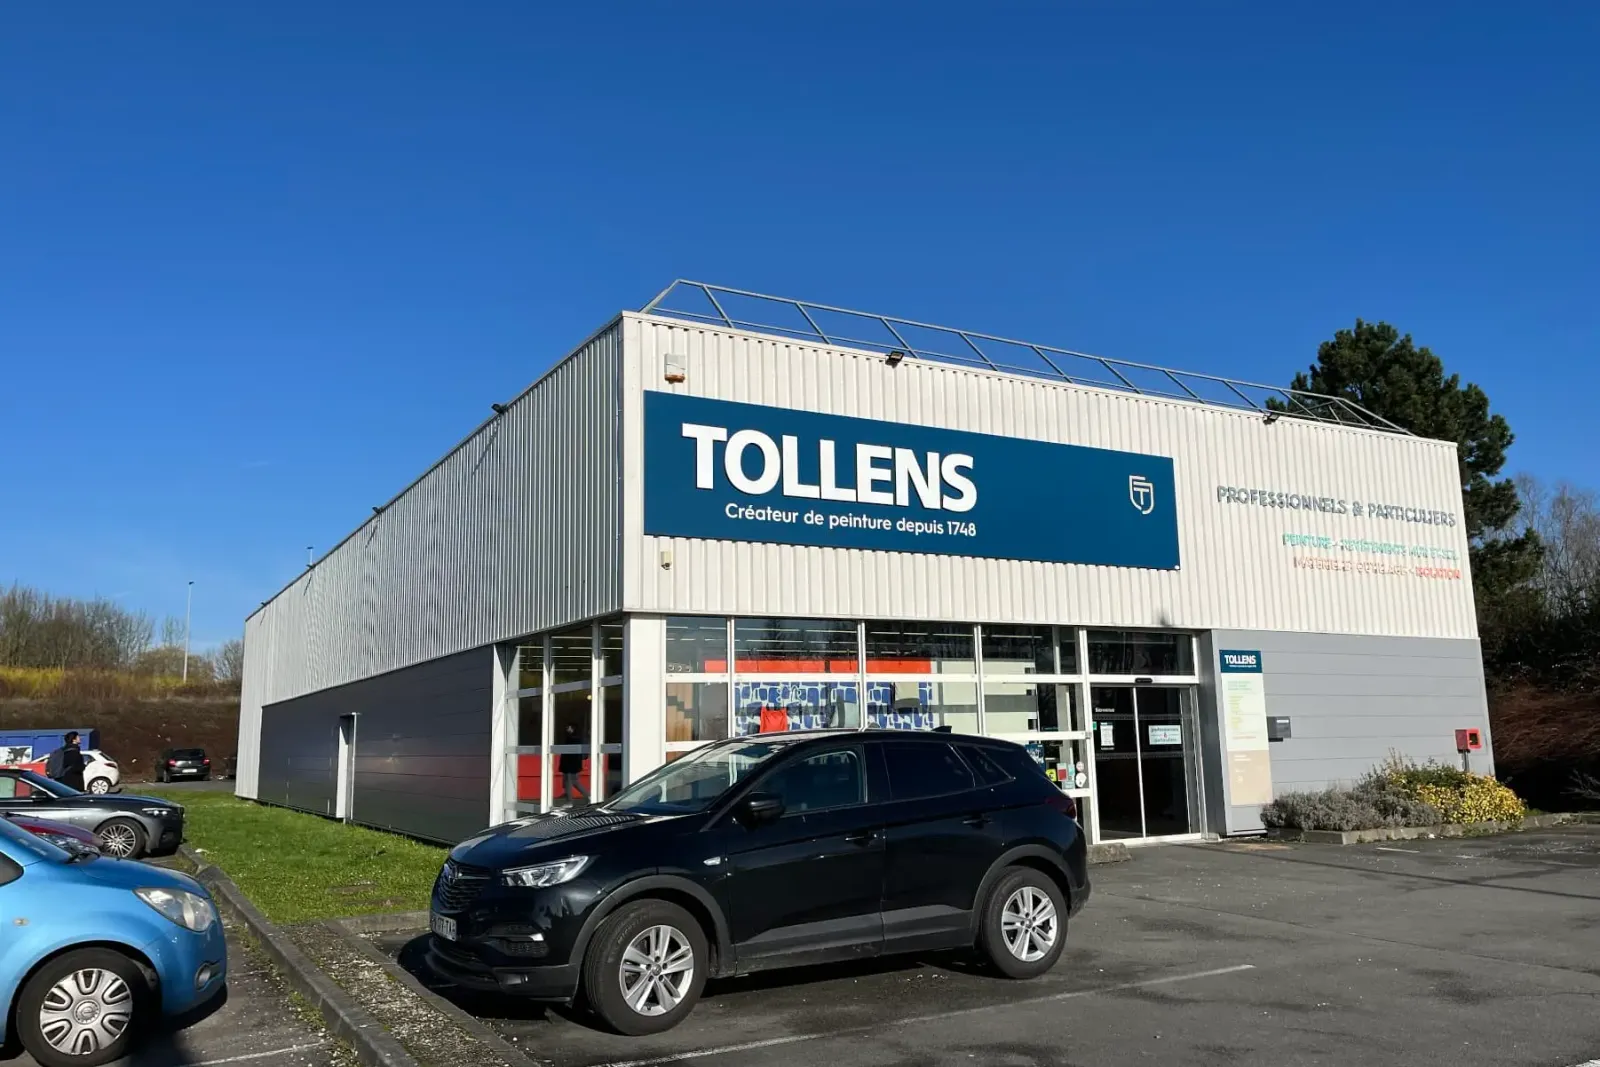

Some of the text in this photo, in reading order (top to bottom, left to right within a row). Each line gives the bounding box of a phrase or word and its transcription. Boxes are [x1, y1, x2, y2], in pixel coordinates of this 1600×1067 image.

[682, 423, 978, 512] TOLLENS
[725, 503, 977, 537] Créateur de peinture depuis 1748
[1217, 485, 1456, 527] PROFESSIONNELS & PARTICULIERS
[1224, 654, 1257, 664] TOLLENS
